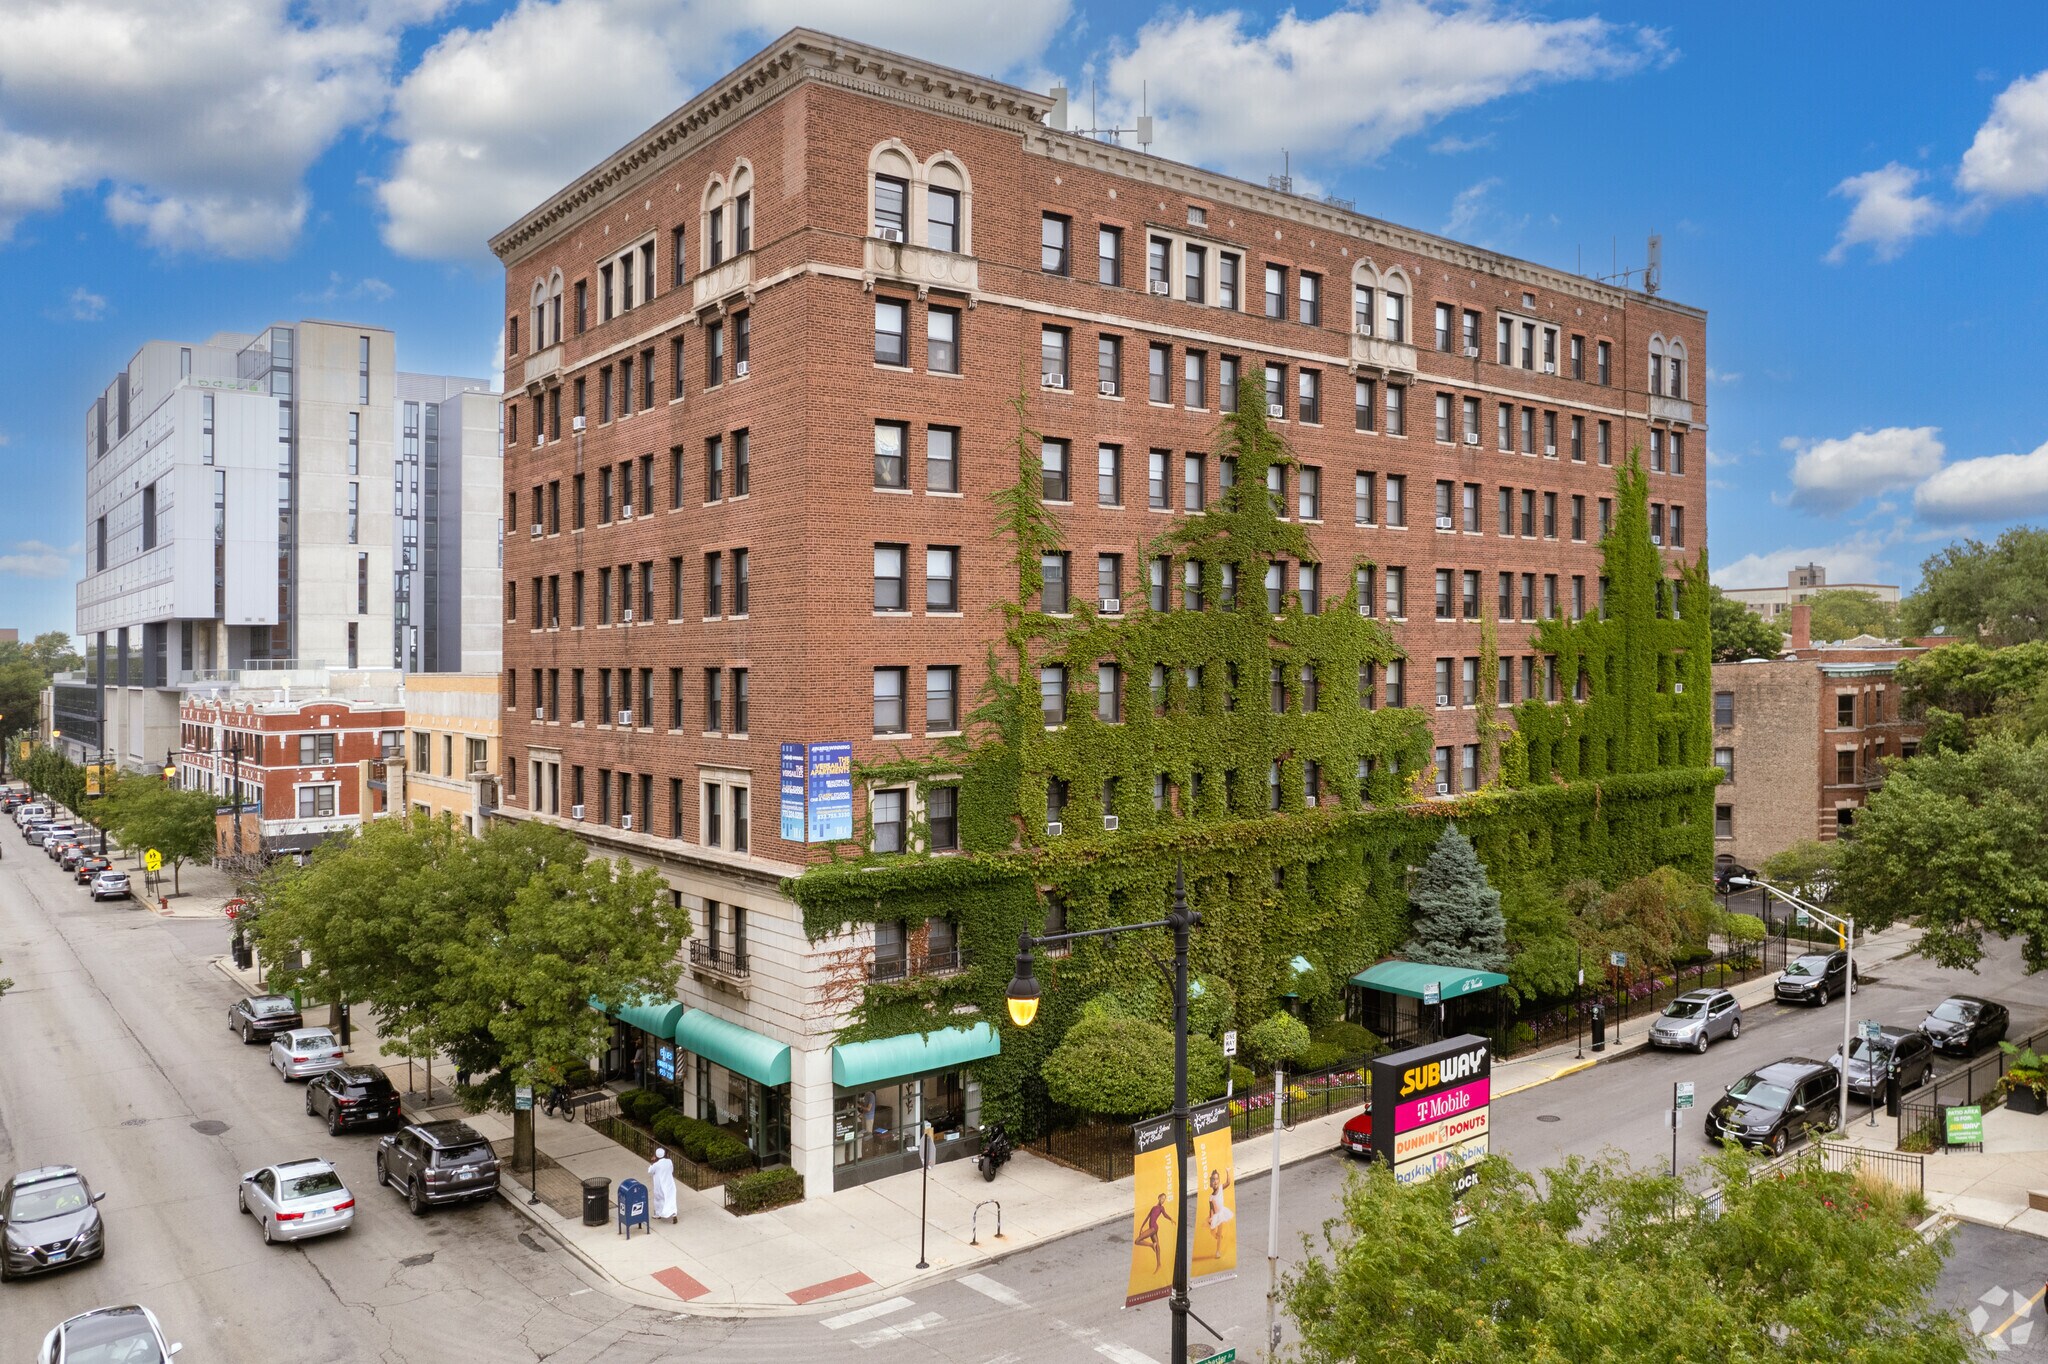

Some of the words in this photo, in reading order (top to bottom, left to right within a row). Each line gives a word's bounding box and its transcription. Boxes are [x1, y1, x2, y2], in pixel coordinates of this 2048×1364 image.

[810, 768, 850, 776] APARTMENTS
[1226, 1033, 1235, 1041] ONE
[1400, 1046, 1487, 1098] SUBWAY
[1396, 1130, 1438, 1155] DUNKIN'
[1449, 1114, 1486, 1137] DONUTS
[1950, 1122, 1980, 1131] SUBWAY
[1165, 1153, 1174, 1203] graceful
[1200, 1143, 1208, 1191] creative
